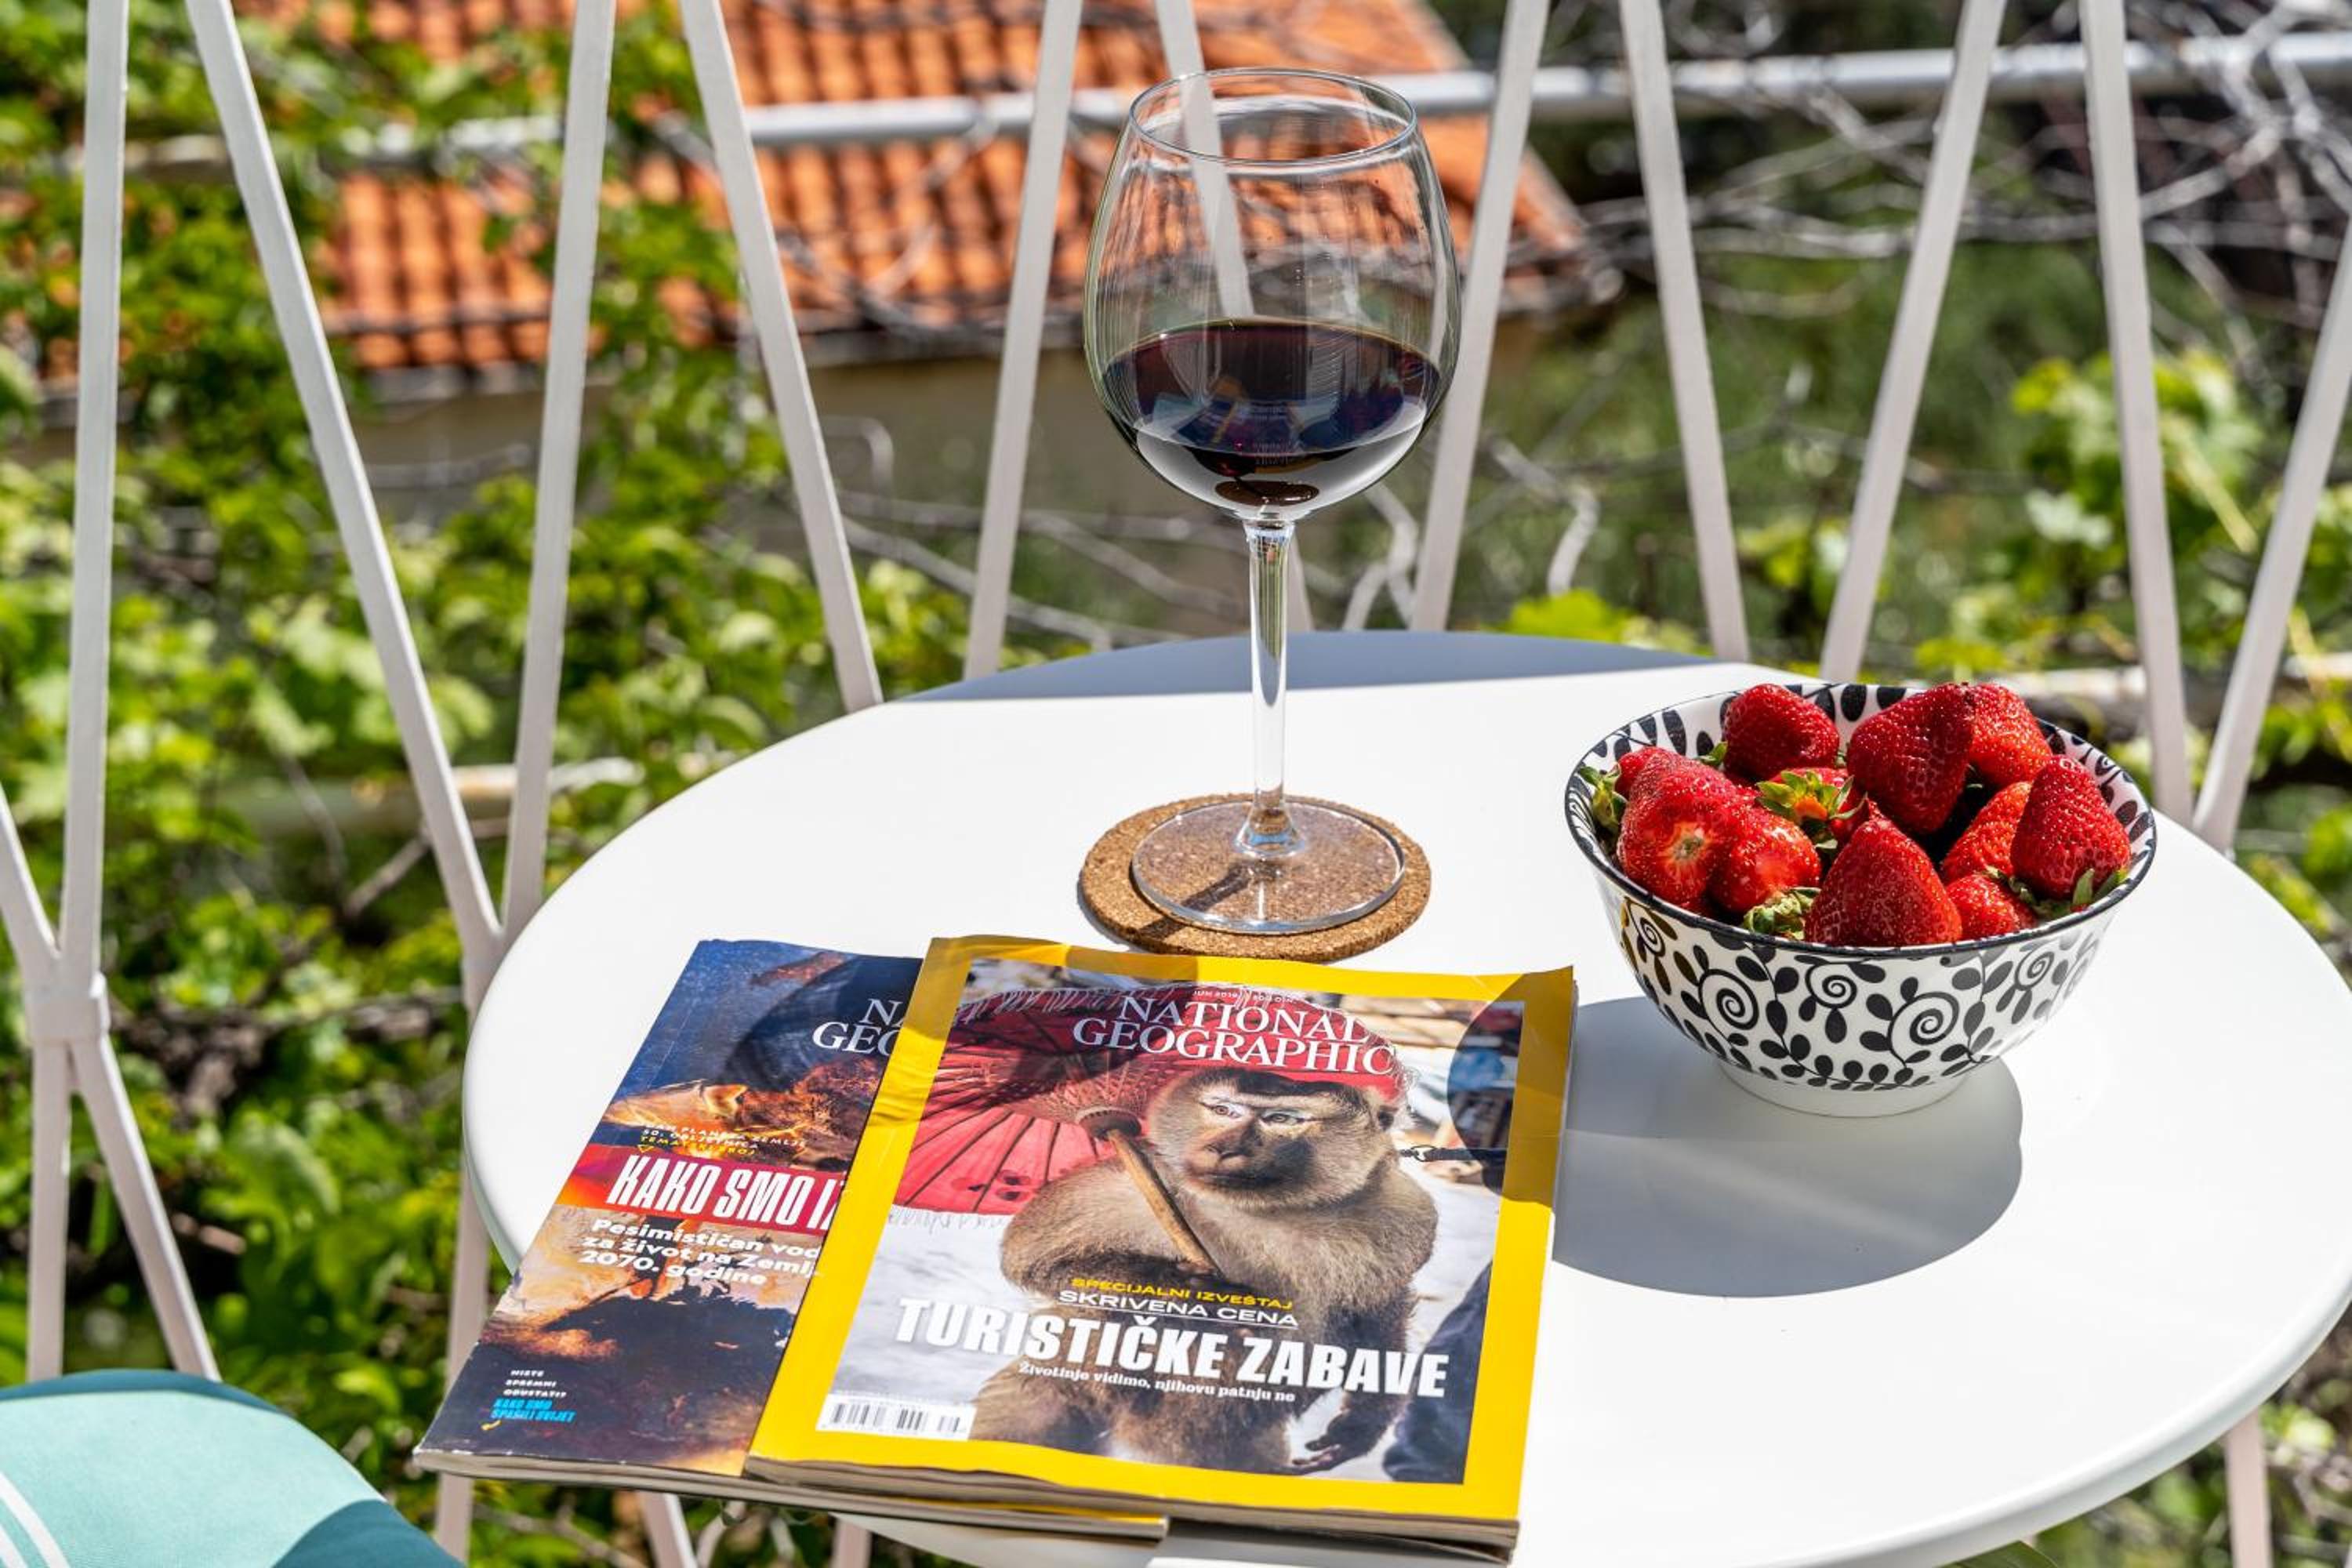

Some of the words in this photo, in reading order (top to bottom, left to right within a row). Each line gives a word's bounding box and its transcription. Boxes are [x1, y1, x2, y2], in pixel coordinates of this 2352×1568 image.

[859, 998, 904, 1027] N
[1118, 996, 1371, 1044] NATIONAL
[1073, 1018, 1395, 1075] GEOGRAPHIC
[606, 1155, 721, 1214] KAKO
[713, 1169, 815, 1225] SMO
[581, 1237, 615, 1250] za
[619, 1238, 693, 1258] život
[699, 1250, 732, 1264] na
[591, 1218, 764, 1252] Pesimističan
[578, 1250, 659, 1272] 2070.
[664, 1264, 767, 1286] godine
[1070, 1277, 1192, 1299] SPECIJALNI
[1058, 1290, 1208, 1316] SKRIVENA
[1215, 1307, 1299, 1326] CENA
[895, 1298, 1229, 1380] TURISTIČKE
[1235, 1337, 1450, 1398] ZABAVE
[1094, 1370, 1152, 1391] vidimo,
[1155, 1379, 1215, 1396] njihovu
[1218, 1386, 1271, 1403] patnju
[1275, 1392, 1296, 1402] ne
